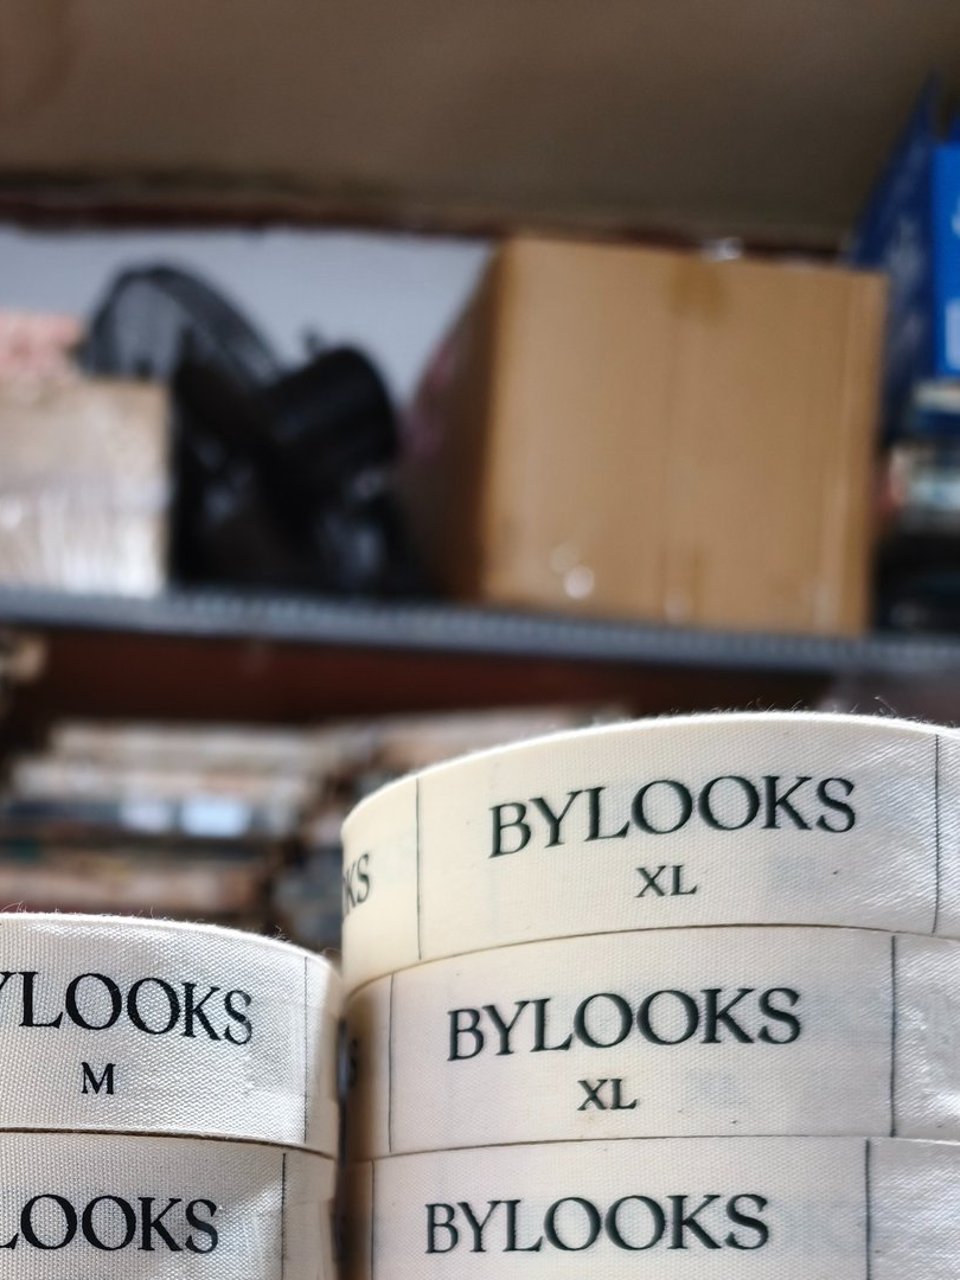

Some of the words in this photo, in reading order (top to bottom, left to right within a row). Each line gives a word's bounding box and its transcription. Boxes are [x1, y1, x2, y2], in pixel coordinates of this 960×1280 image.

[488, 776, 857, 859] BYLOOKS
[635, 865, 698, 899] XL
[446, 986, 802, 1062] BYLOOKS
[81, 1062, 116, 1095] M
[576, 1078, 638, 1112] XL
[424, 1194, 769, 1254] BYLOOKS
